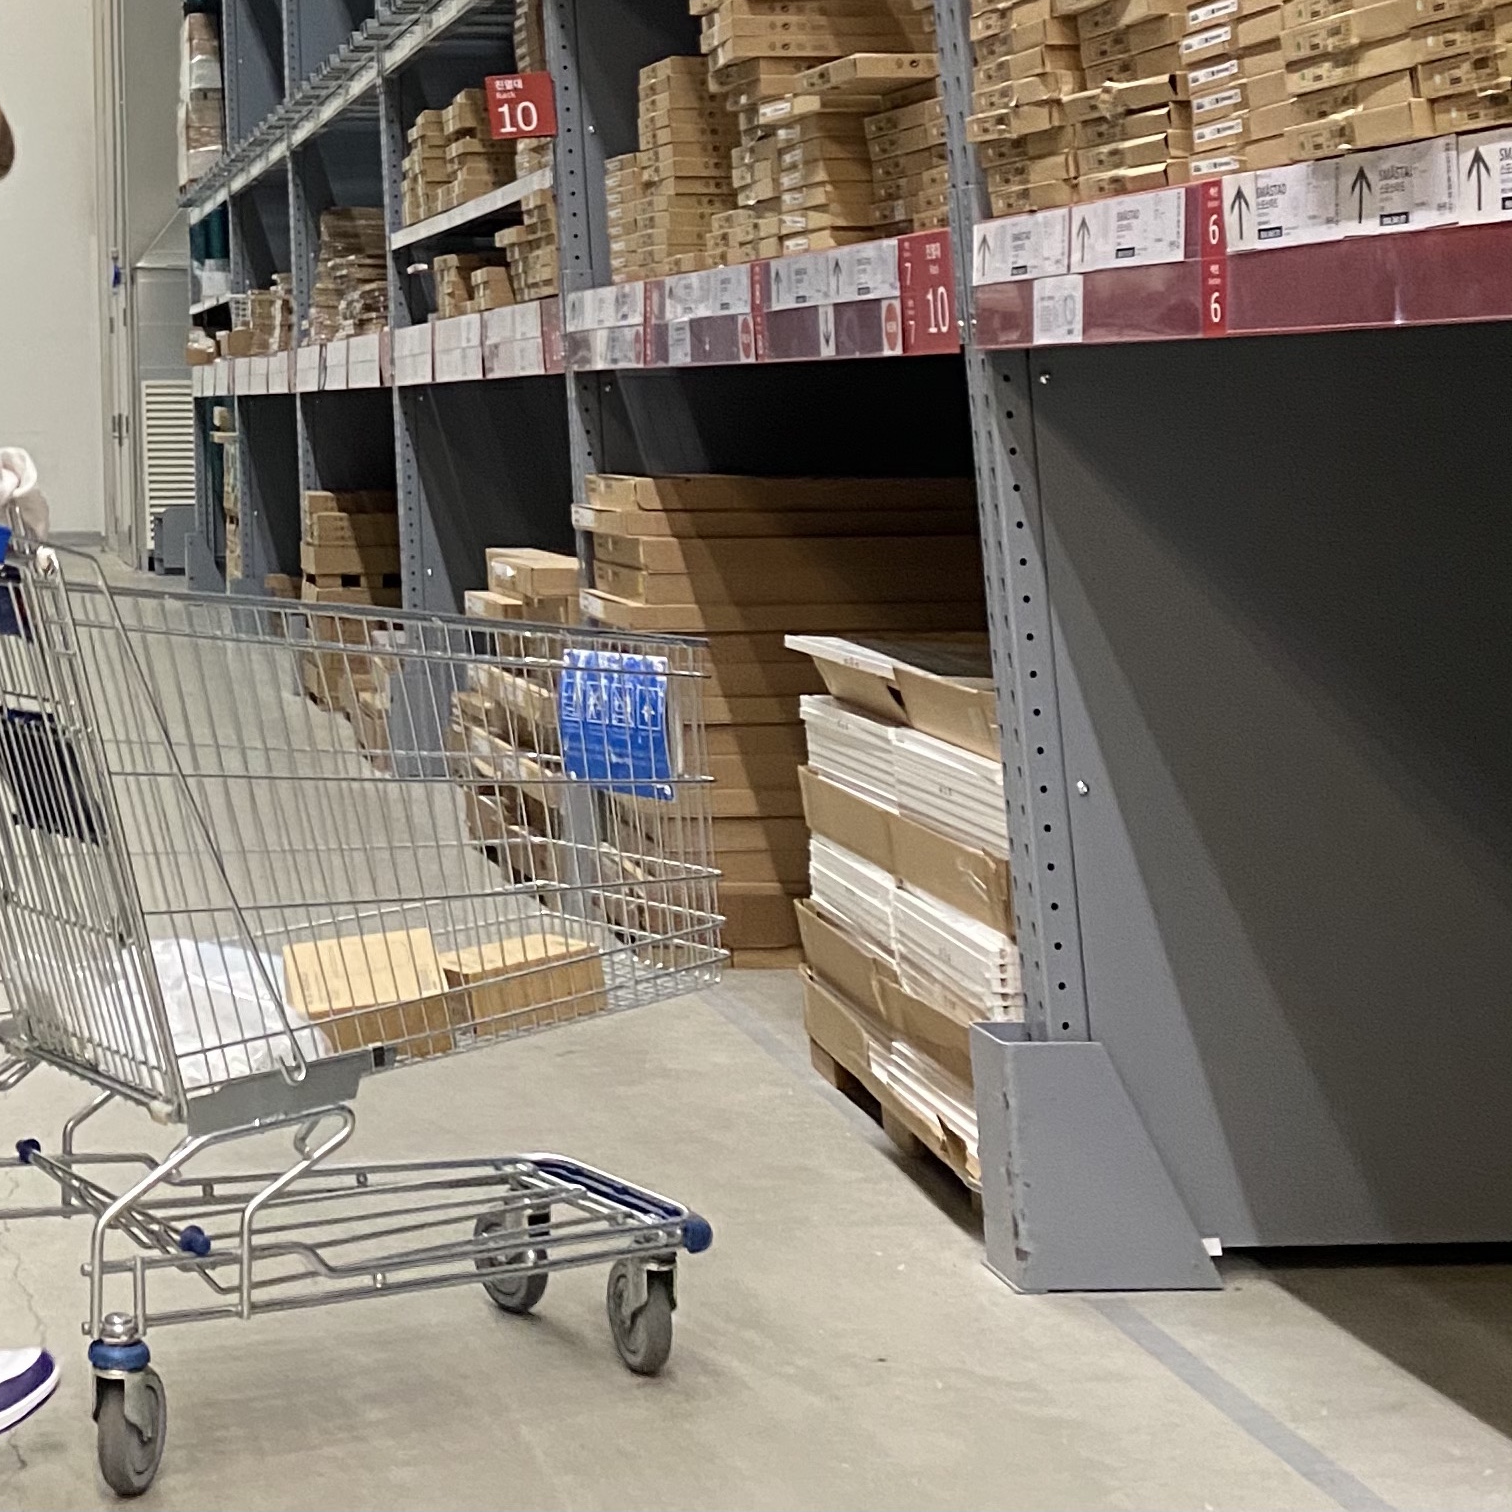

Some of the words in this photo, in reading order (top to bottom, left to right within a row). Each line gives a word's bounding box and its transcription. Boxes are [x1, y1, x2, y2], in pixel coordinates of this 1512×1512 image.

[497, 100, 538, 133] 10
[1208, 213, 1220, 245] 6
[904, 262, 912, 286] 7
[925, 285, 950, 334] 10
[1210, 291, 1221, 323] 6
[908, 319, 916, 345] 7
